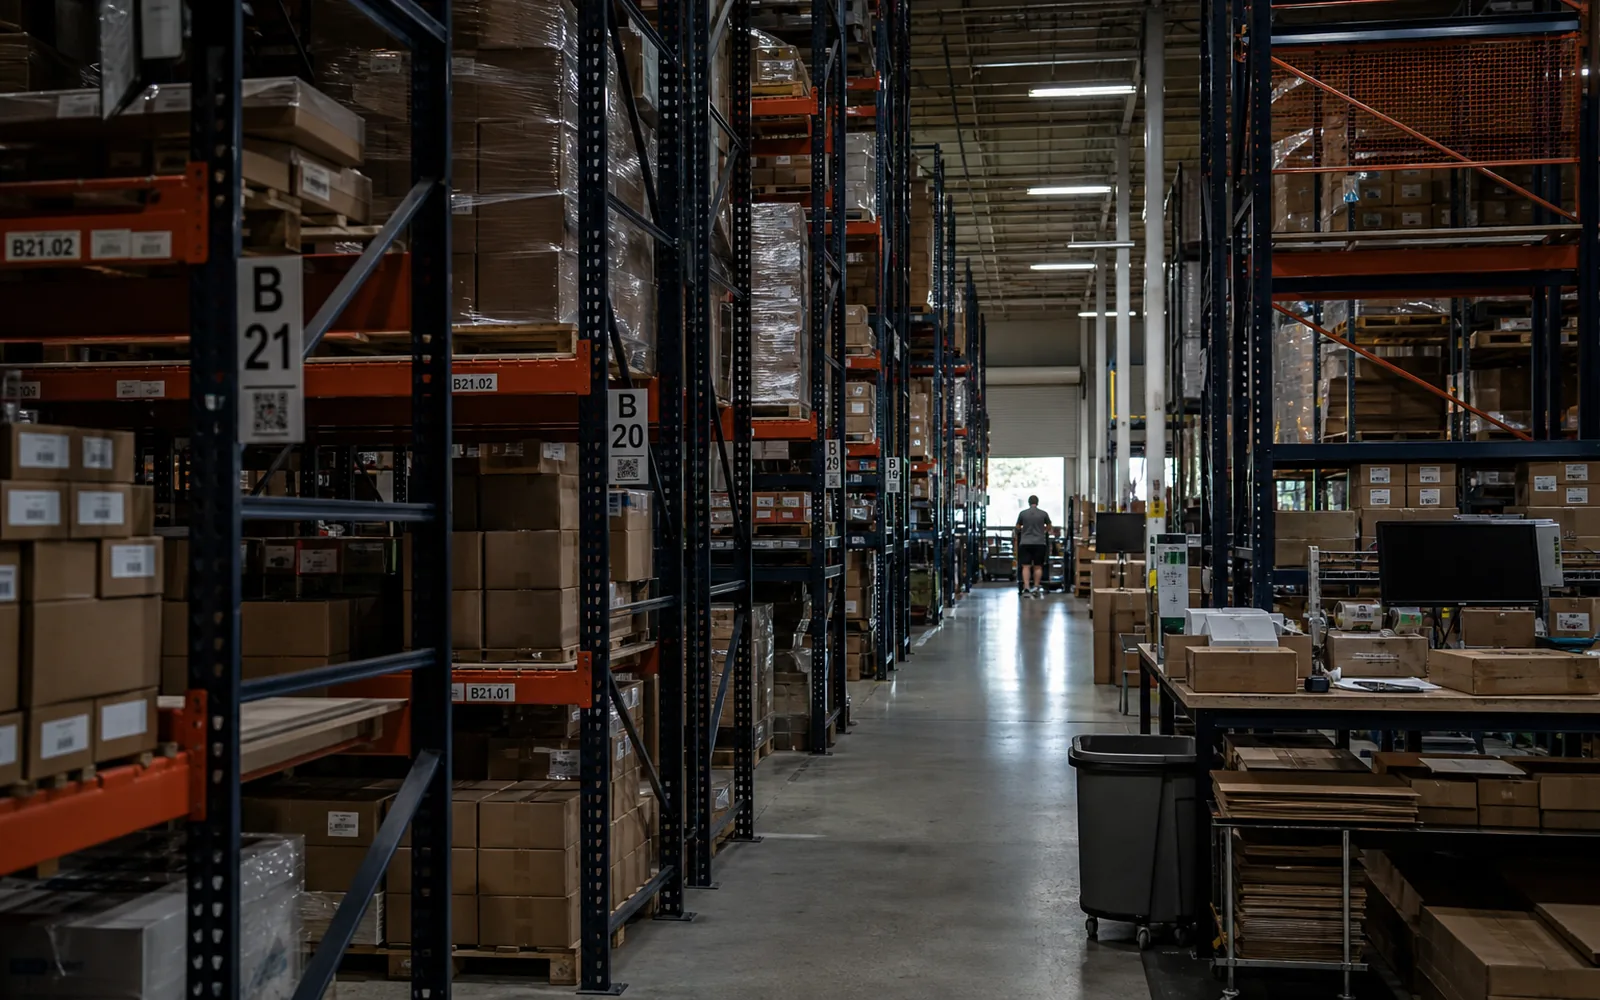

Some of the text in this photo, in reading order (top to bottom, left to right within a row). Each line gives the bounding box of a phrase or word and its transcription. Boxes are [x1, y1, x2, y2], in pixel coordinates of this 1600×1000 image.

[12, 238, 74, 257] B21.02
[253, 266, 283, 313] B
[244, 323, 290, 371] 21
[453, 377, 493, 390] B21.02
[618, 393, 637, 418] B
[612, 423, 644, 448] 20
[828, 442, 837, 456] B
[889, 459, 896, 469] B
[471, 687, 510, 699] B21.01
